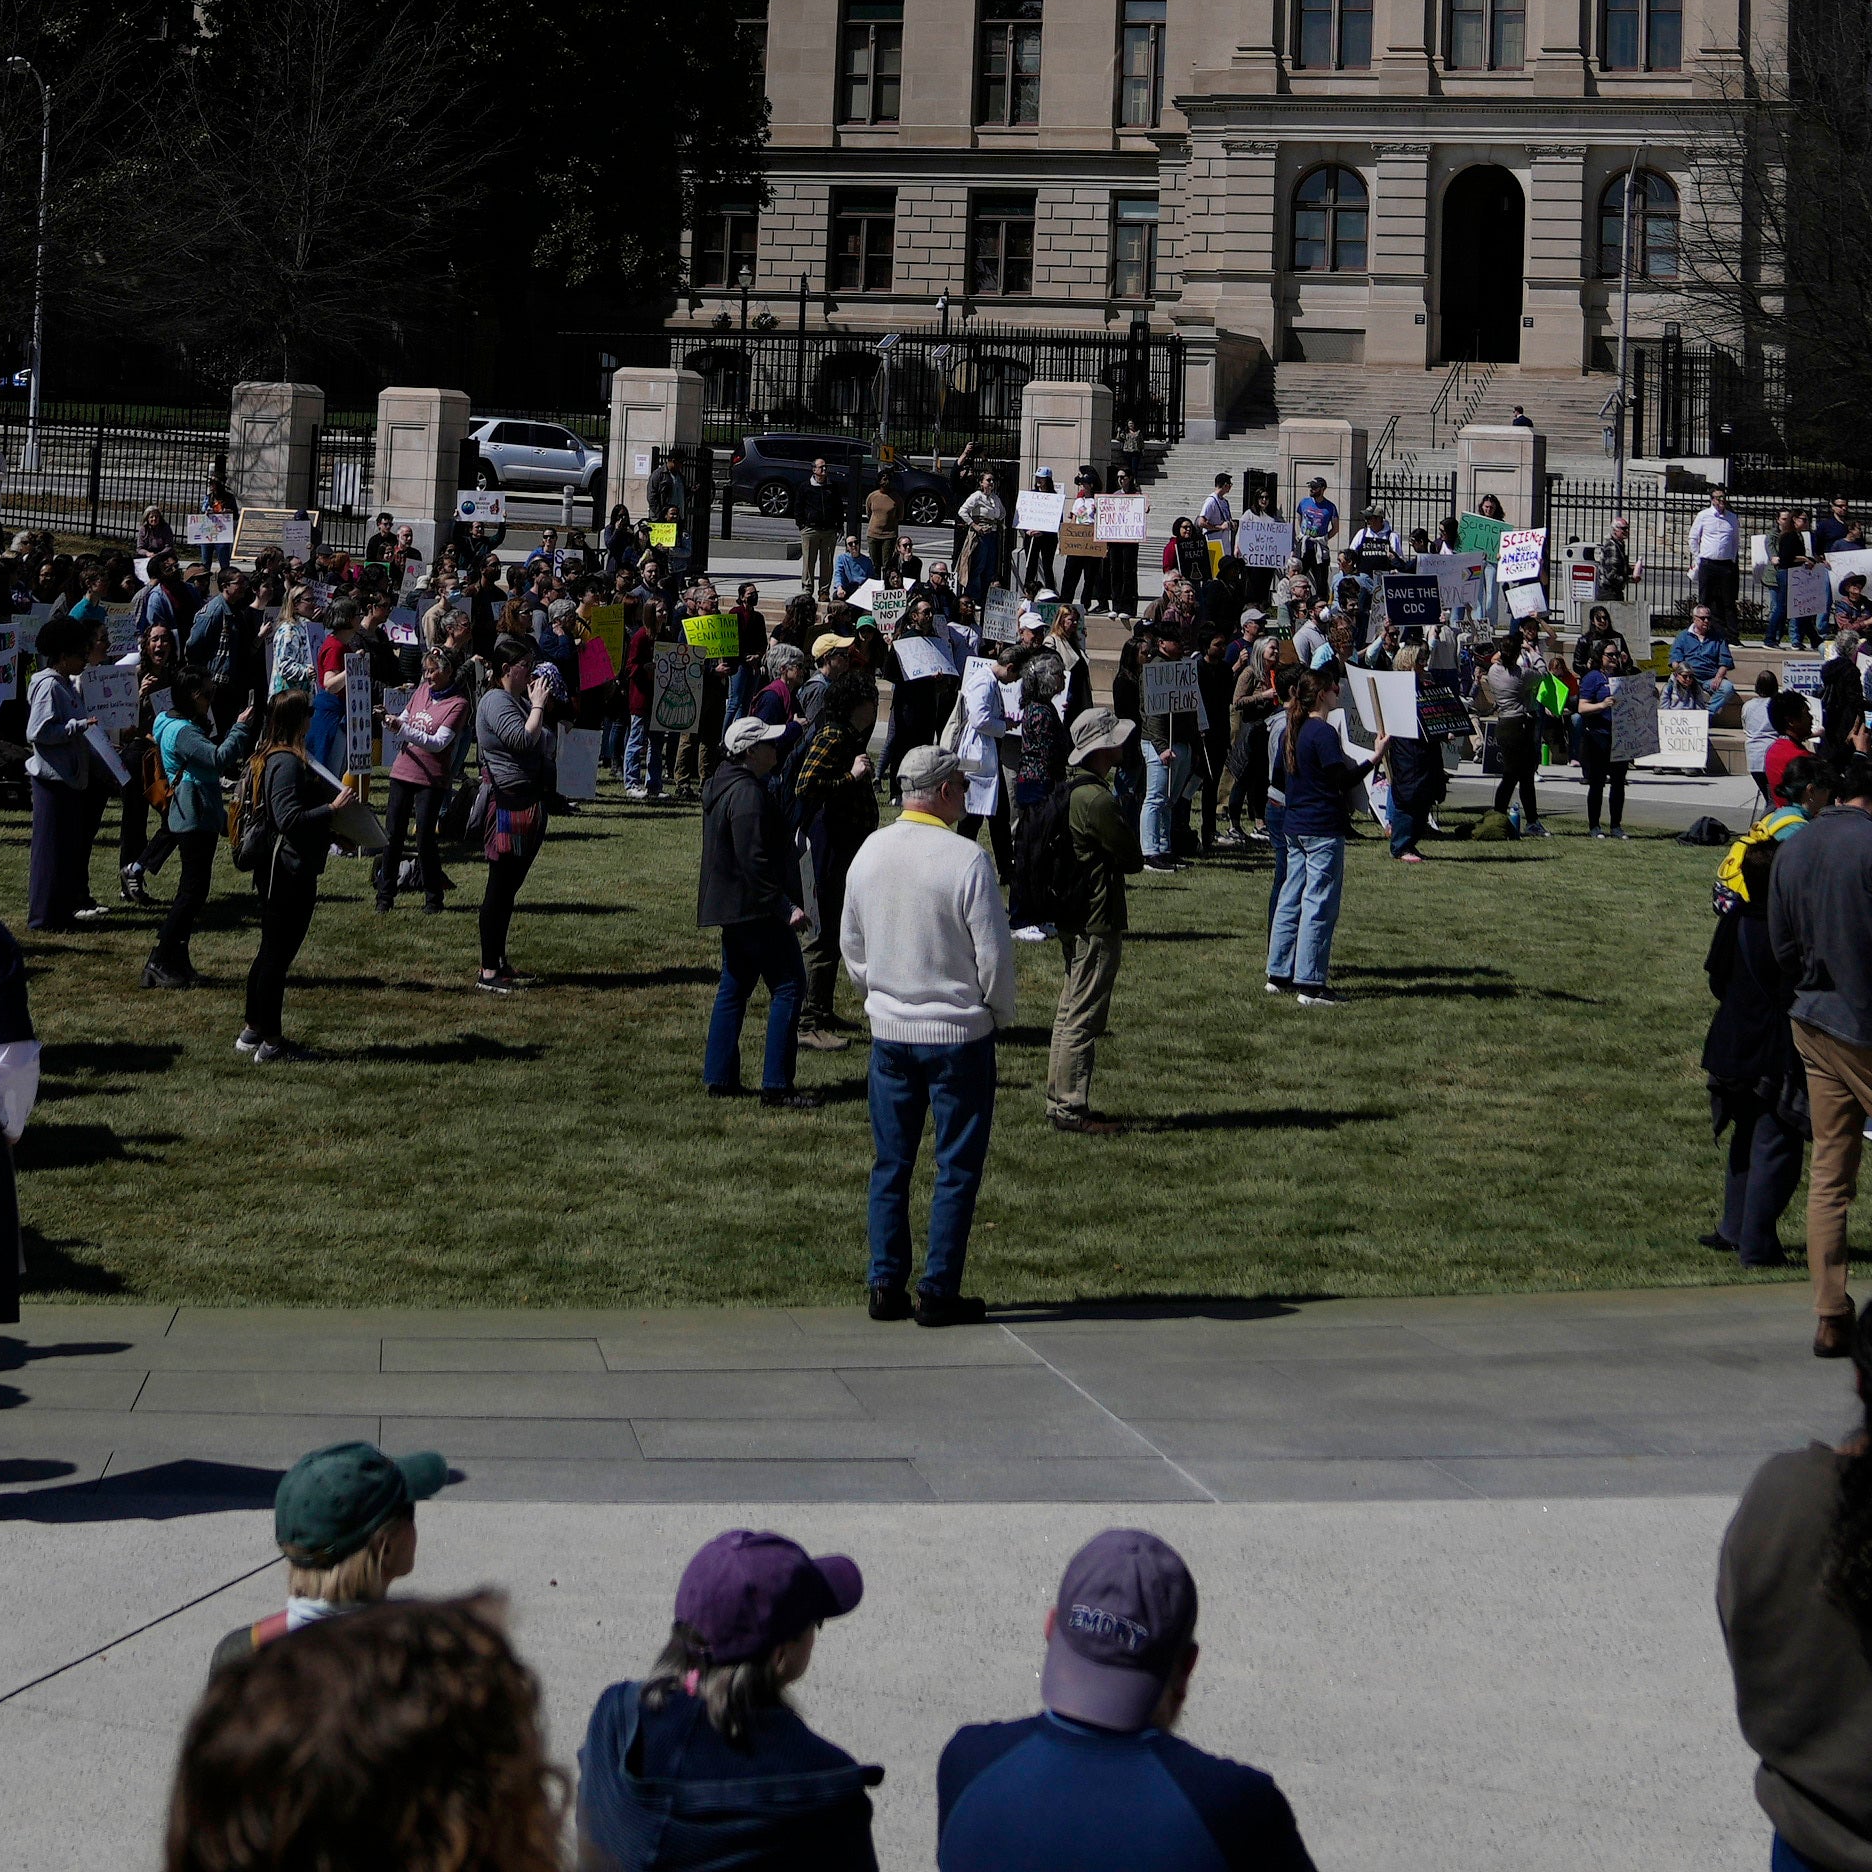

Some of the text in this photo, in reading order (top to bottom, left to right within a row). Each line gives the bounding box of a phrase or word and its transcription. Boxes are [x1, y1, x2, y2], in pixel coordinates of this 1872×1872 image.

[1180, 540, 1205, 549] TIME TO
[1474, 534, 1499, 553] LIV
[1502, 532, 1545, 548] SCIENCE
[1184, 550, 1204, 559] REACT
[1502, 551, 1539, 564] AMERICA
[875, 590, 903, 600] FUND
[1387, 587, 1438, 599] SAVE THE
[873, 600, 907, 611] SCIENCE
[1403, 603, 1426, 614] CDC
[880, 610, 899, 619] NOT
[684, 618, 716, 632] EVER
[1145, 666, 1174, 687] FUND
[1783, 675, 1822, 684] SUPPO
[1147, 693, 1168, 713] NOT
[1670, 716, 1689, 726] OUR
[1664, 726, 1701, 735] PLANET
[1668, 738, 1707, 752] SCIENCE
[1069, 1604, 1150, 1651] EMORY
